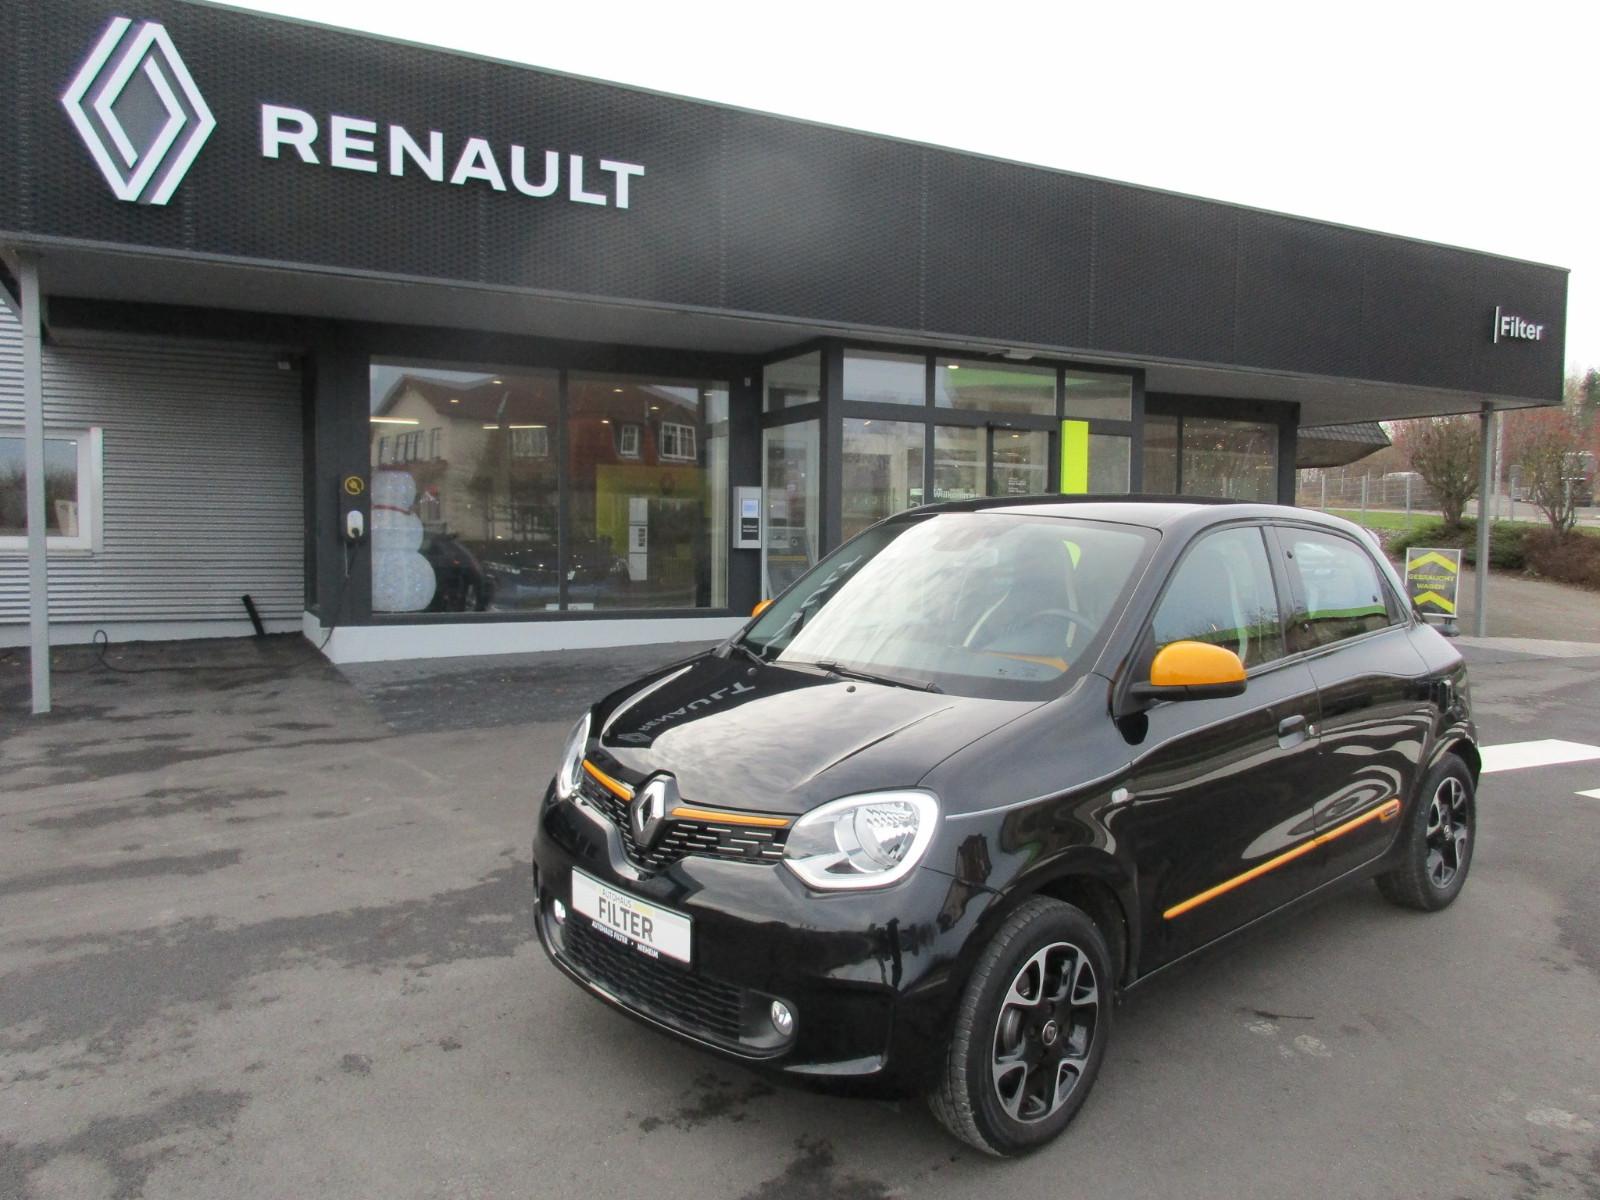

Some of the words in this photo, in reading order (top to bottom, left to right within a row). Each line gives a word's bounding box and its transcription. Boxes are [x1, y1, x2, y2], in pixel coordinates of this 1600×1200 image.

[261, 104, 645, 209] RENAULT
[1500, 315, 1544, 341] Filter
[599, 896, 653, 942] FILTER
